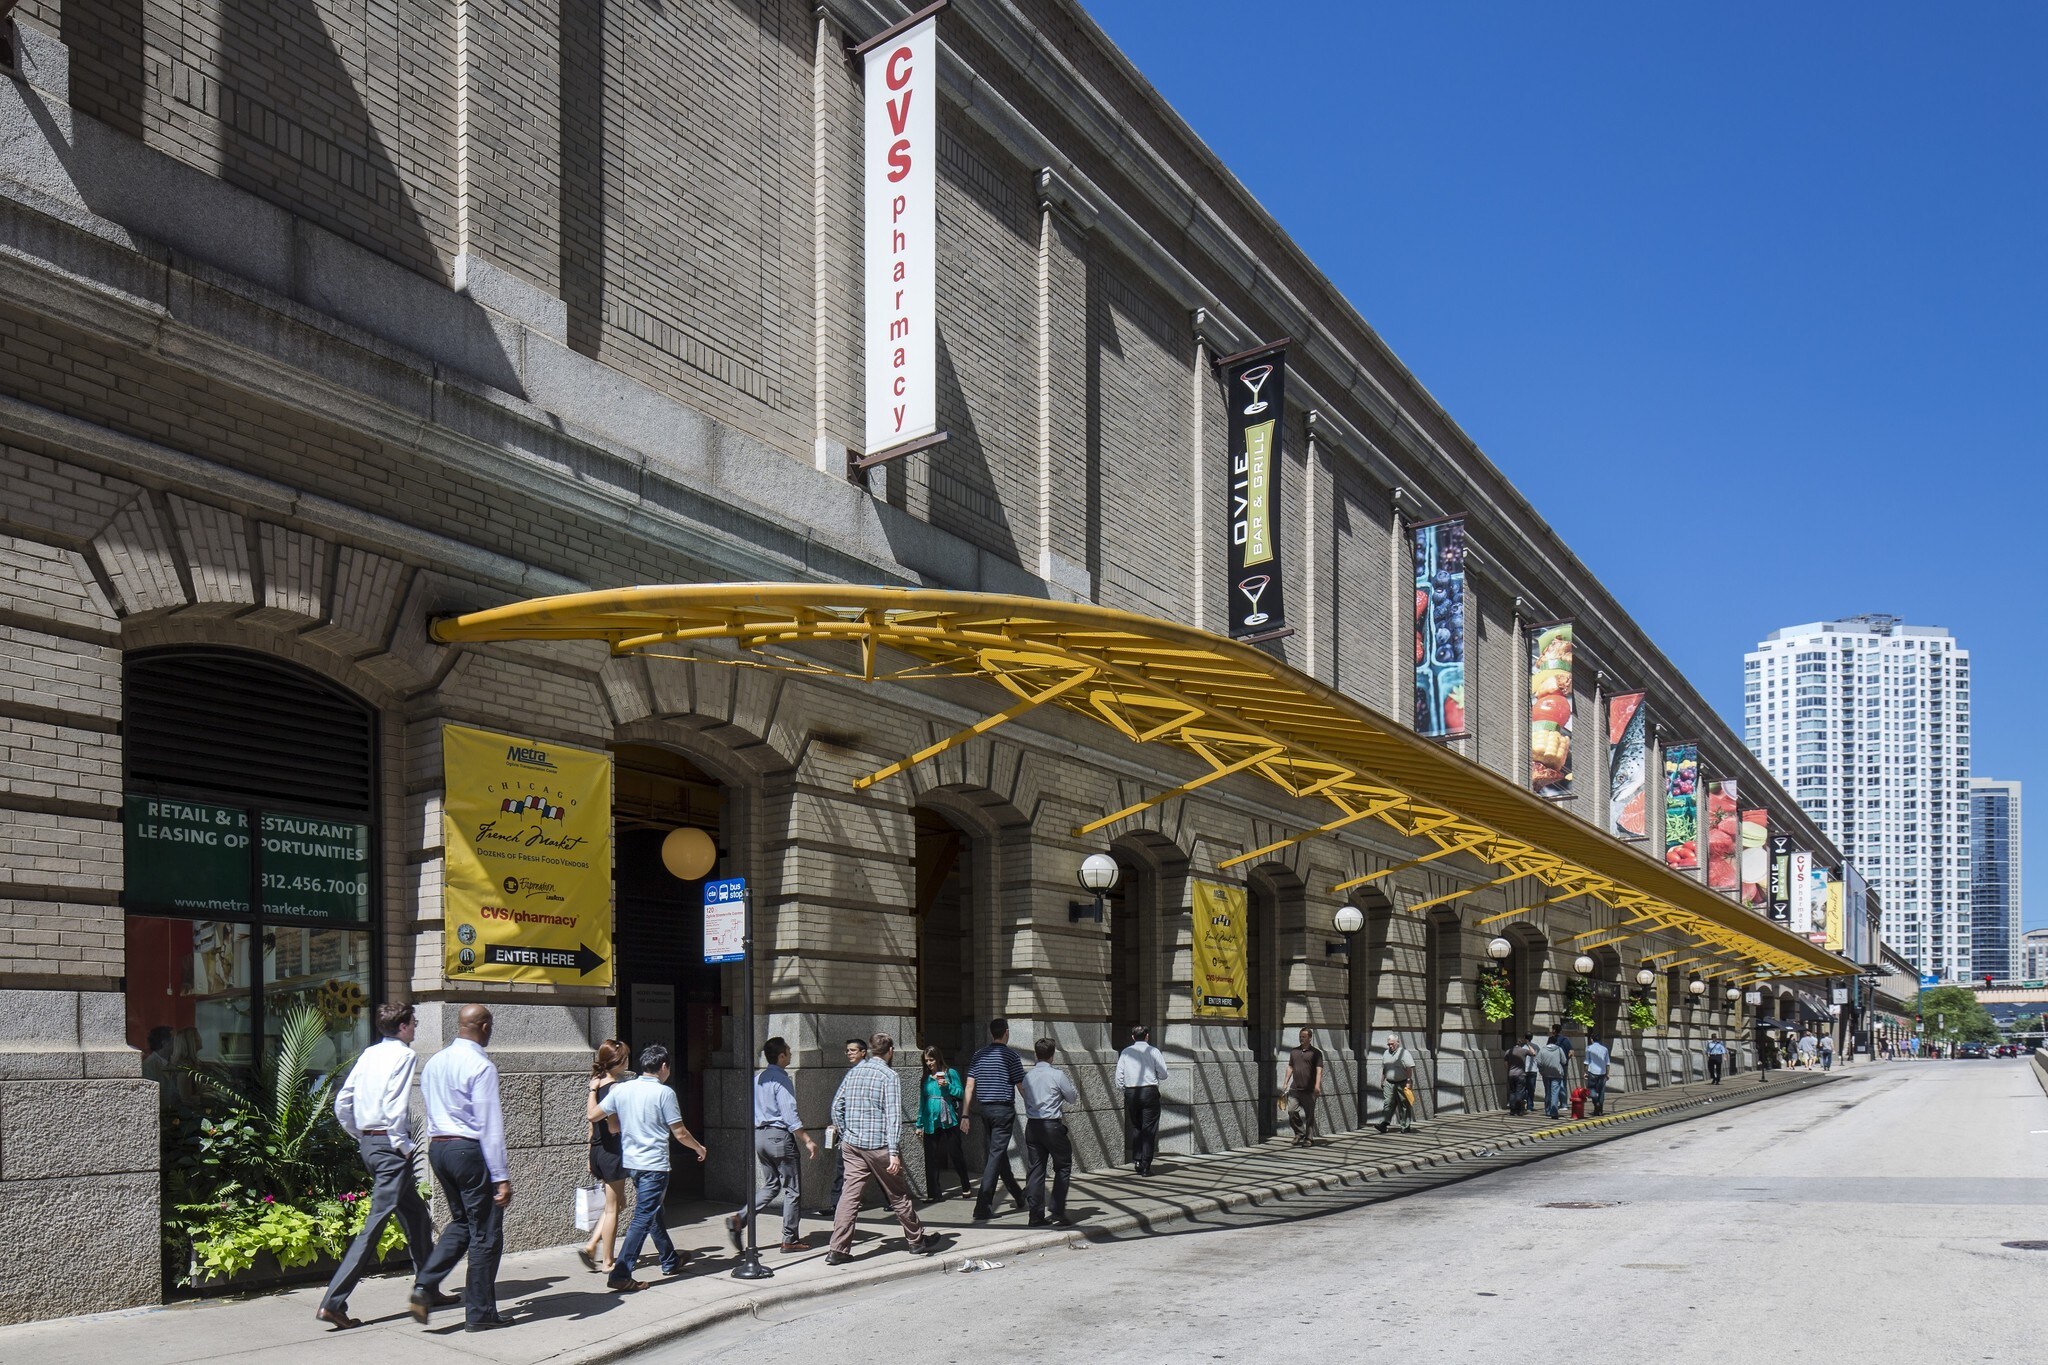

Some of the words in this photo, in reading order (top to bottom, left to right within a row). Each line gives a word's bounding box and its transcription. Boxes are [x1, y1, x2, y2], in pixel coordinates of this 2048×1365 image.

[885, 45, 914, 184] CVS
[889, 193, 910, 433] pharmacy
[1253, 430, 1265, 488] GRILL
[1234, 452, 1249, 546] OVIE
[1253, 494, 1263, 509] &
[1253, 518, 1263, 556] BAR
[506, 745, 546, 762] Metra
[487, 780, 577, 807] CHICAGO
[148, 802, 210, 824] RETAIL
[215, 809, 231, 826] &
[138, 823, 217, 847] LEASING
[475, 820, 524, 843] French
[525, 824, 588, 851] Market
[477, 848, 506, 860] DOZENS
[518, 852, 540, 863] FRESH
[541, 855, 560, 865] FOOD
[560, 857, 590, 869] VENDORS
[261, 873, 367, 896] 312.456.7000
[729, 882, 741, 891] bus
[729, 889, 744, 899] stop
[480, 906, 577, 929] CVS/pharmacy
[495, 949, 538, 964] ENTER
[541, 952, 575, 966] HERE
